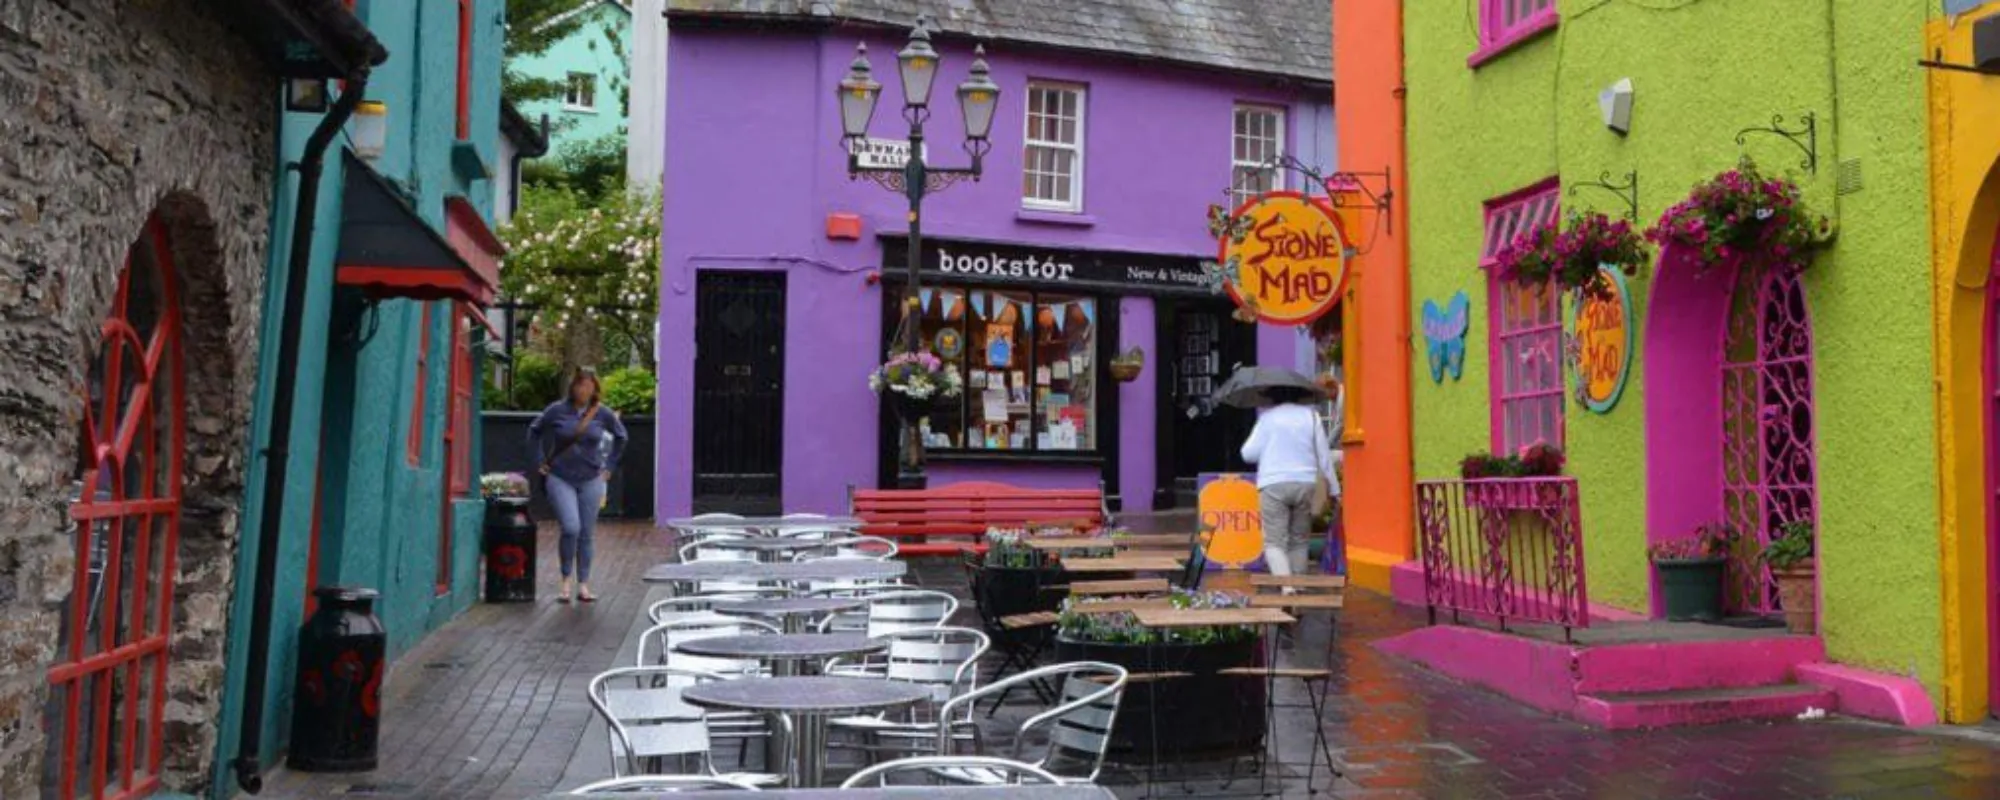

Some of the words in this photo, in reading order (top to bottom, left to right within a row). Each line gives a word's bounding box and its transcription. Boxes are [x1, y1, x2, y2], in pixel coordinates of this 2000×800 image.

[1246, 212, 1339, 264] STONE
[938, 248, 1074, 281] bookstór
[1127, 266, 1156, 279] New
[1158, 267, 1168, 280] &
[1259, 265, 1332, 304] MAD
[1201, 510, 1262, 532] OPEN
